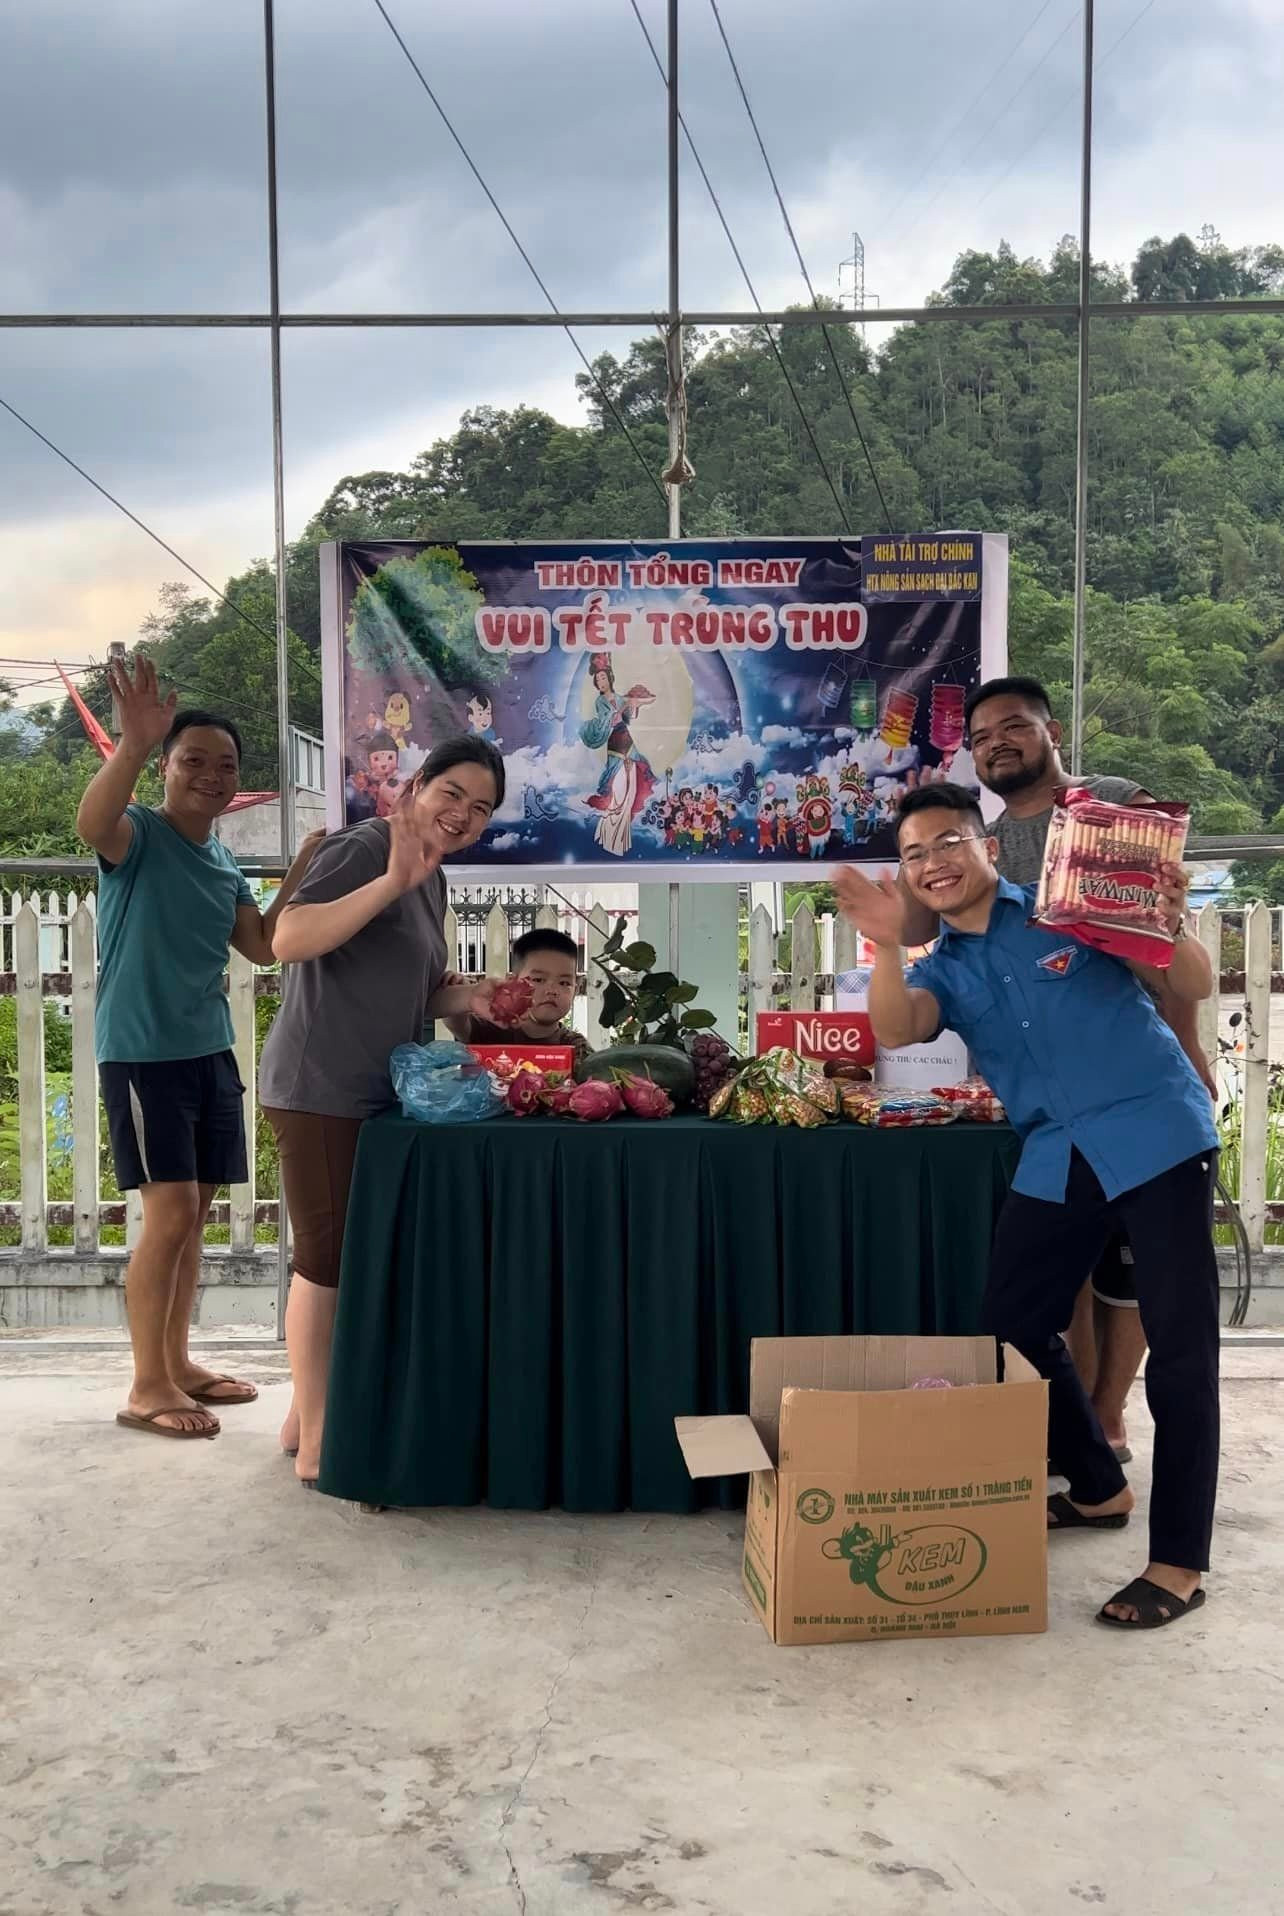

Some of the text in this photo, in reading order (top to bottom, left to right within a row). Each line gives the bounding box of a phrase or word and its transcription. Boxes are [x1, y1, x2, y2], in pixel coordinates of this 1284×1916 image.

[873, 540, 896, 562] NHÀ
[919, 541, 939, 565] TRỢ
[941, 539, 974, 561] CHÍNH
[537, 554, 802, 586] THÔN TỔNG NGAY
[482, 613, 545, 647] VUI
[559, 597, 632, 646] TẾT
[786, 610, 862, 643] THU
[794, 1018, 861, 1057] Nice
[844, 1490, 865, 1506] NHÀ
[867, 1488, 889, 1505] MÁY
[890, 1487, 911, 1504] SẢN
[939, 1487, 959, 1501] KEM
[897, 1537, 966, 1575] KEM
